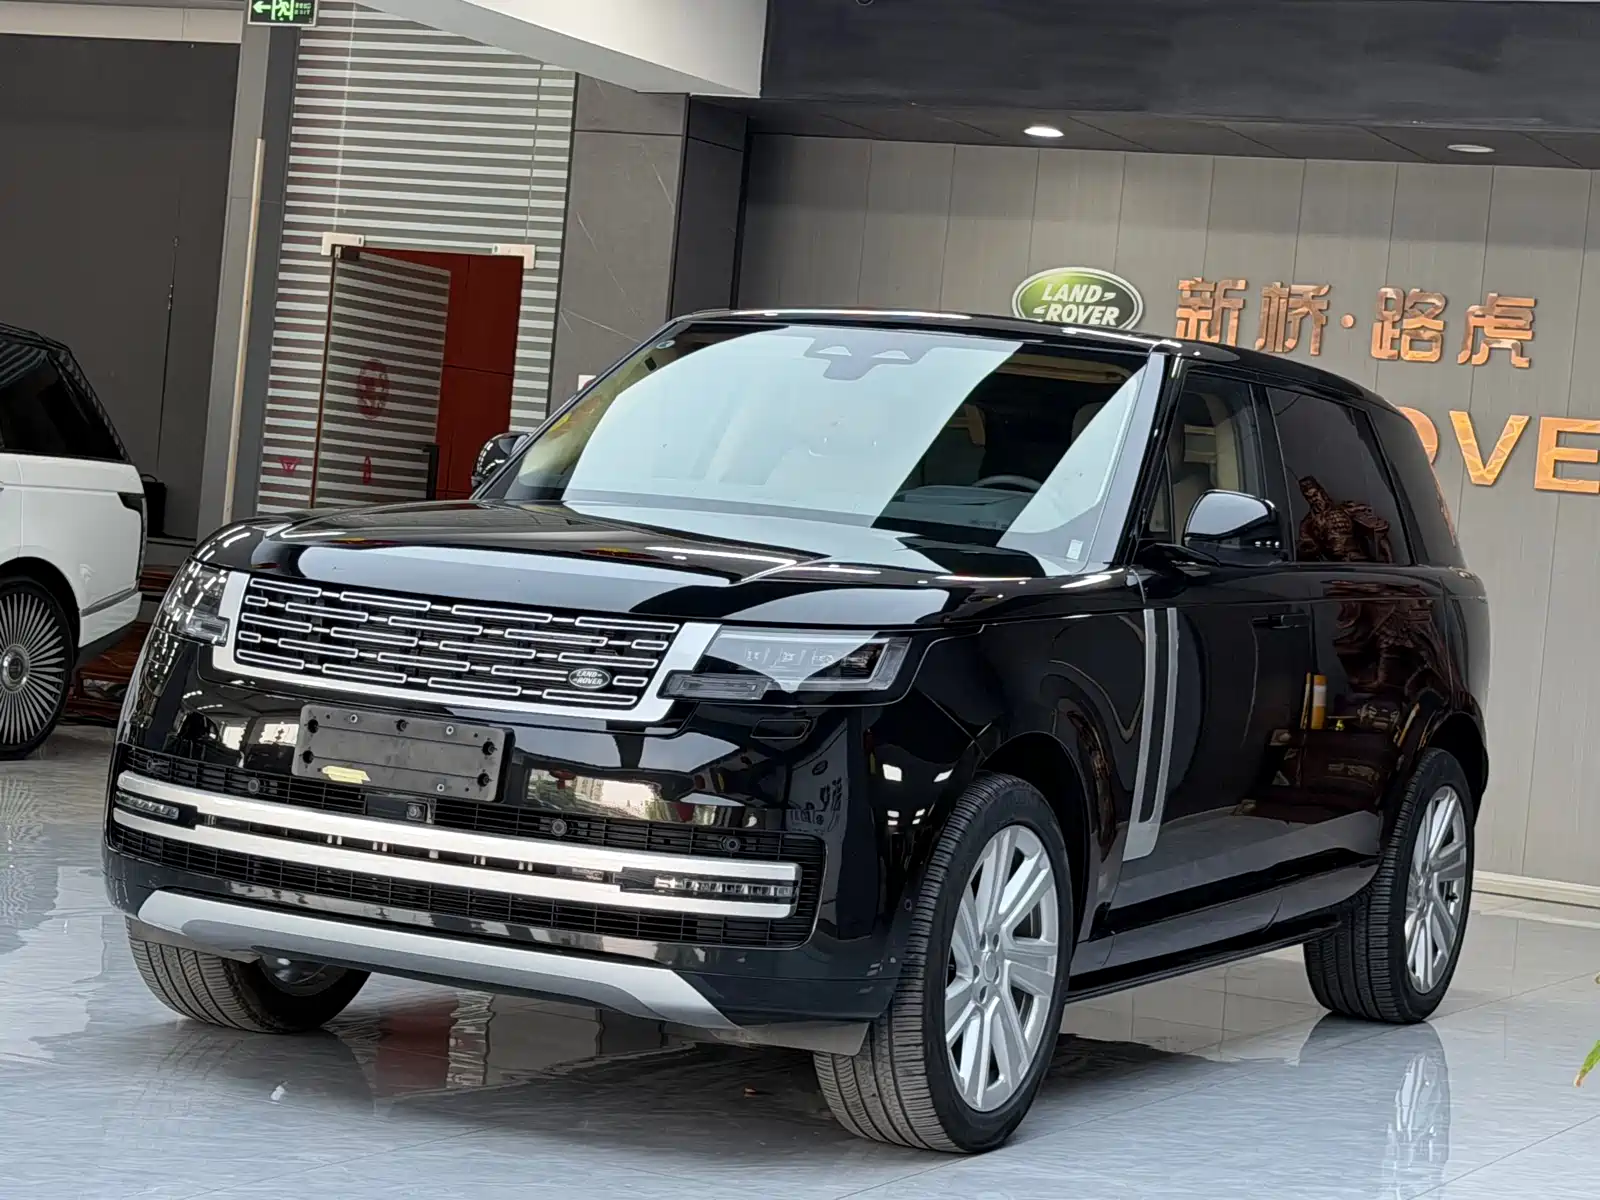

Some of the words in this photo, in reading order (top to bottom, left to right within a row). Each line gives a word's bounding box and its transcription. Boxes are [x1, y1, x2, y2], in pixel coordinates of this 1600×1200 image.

[1041, 283, 1103, 303] LAND
[1044, 303, 1120, 326] ROVER
[576, 670, 598, 678] LAND
[576, 677, 603, 685] ROVER
